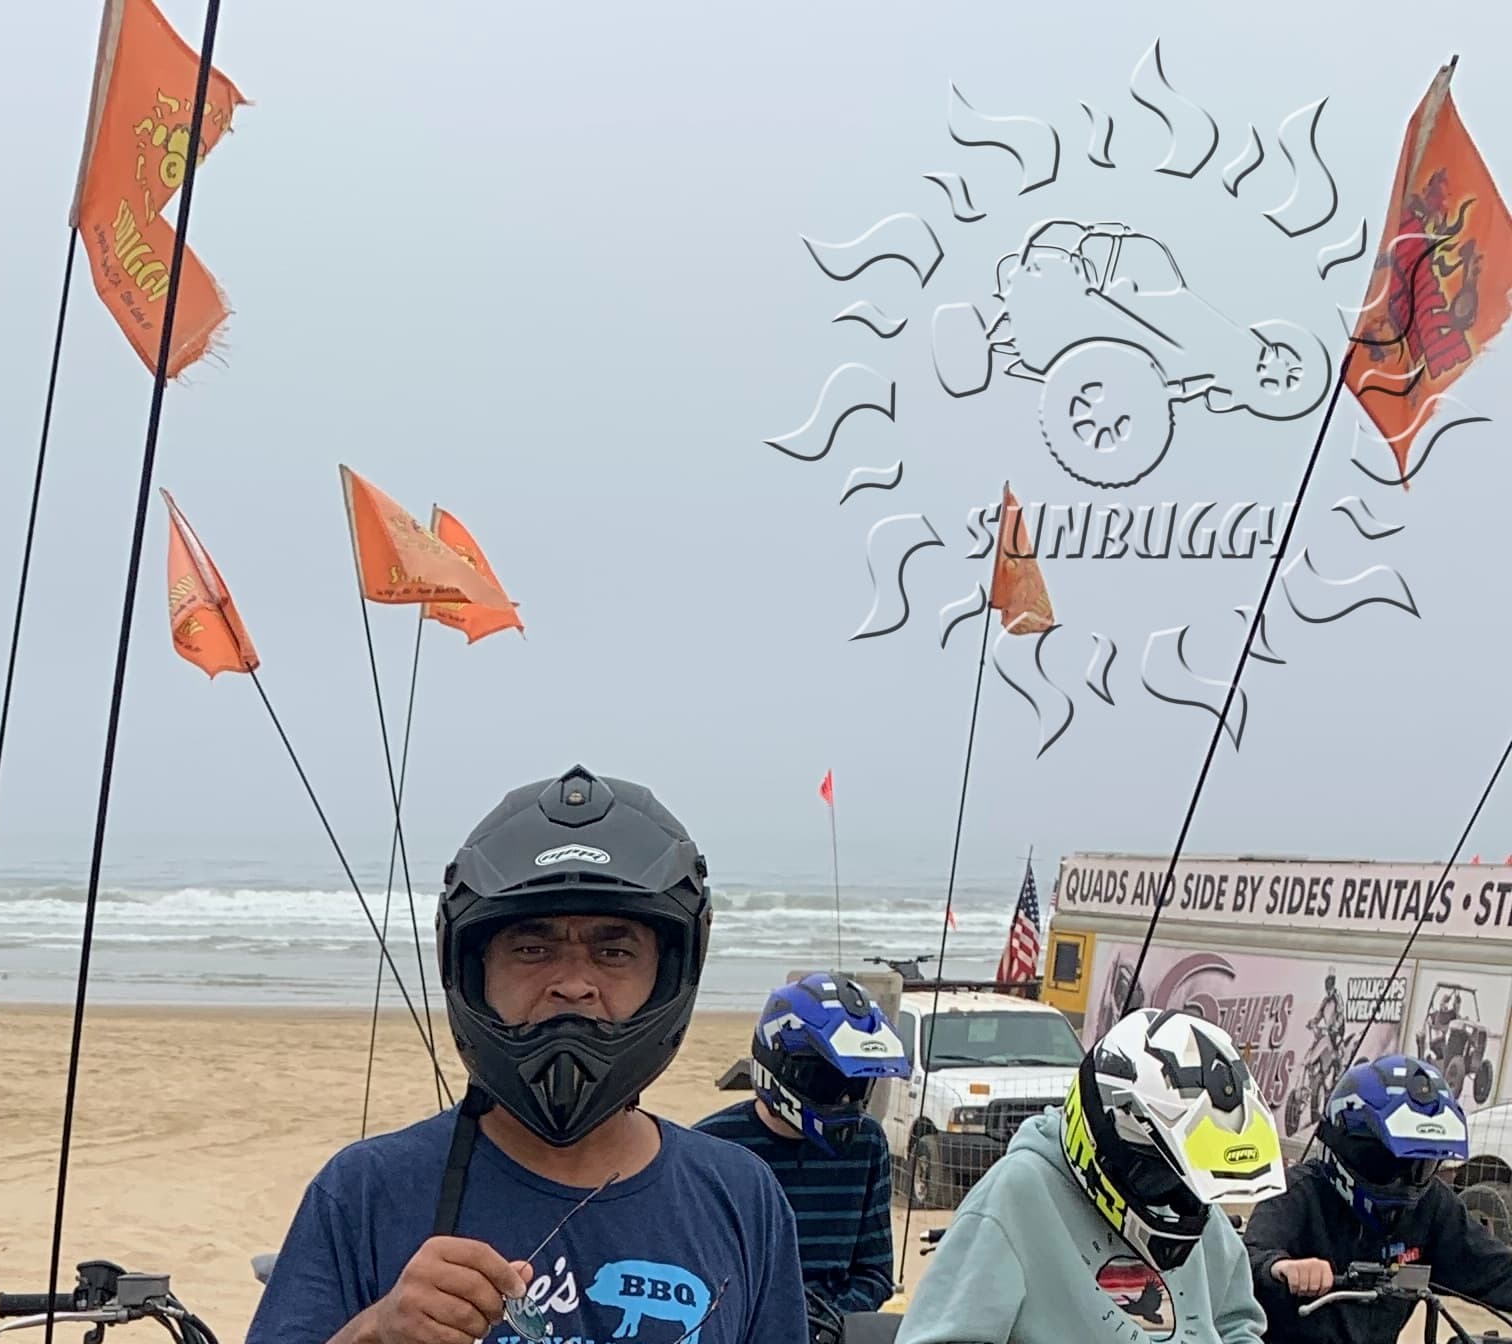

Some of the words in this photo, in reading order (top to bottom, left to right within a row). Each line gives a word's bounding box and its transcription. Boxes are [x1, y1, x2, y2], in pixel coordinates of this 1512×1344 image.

[1065, 867, 1129, 905] QUADS
[1131, 870, 1177, 907] AND
[1180, 872, 1229, 911] SIDE
[1232, 874, 1264, 912] BY
[1265, 874, 1334, 918] SIDES
[1338, 878, 1455, 924] RENTALS
[1474, 881, 1512, 927] ST
[619, 1274, 697, 1308] BBQ
